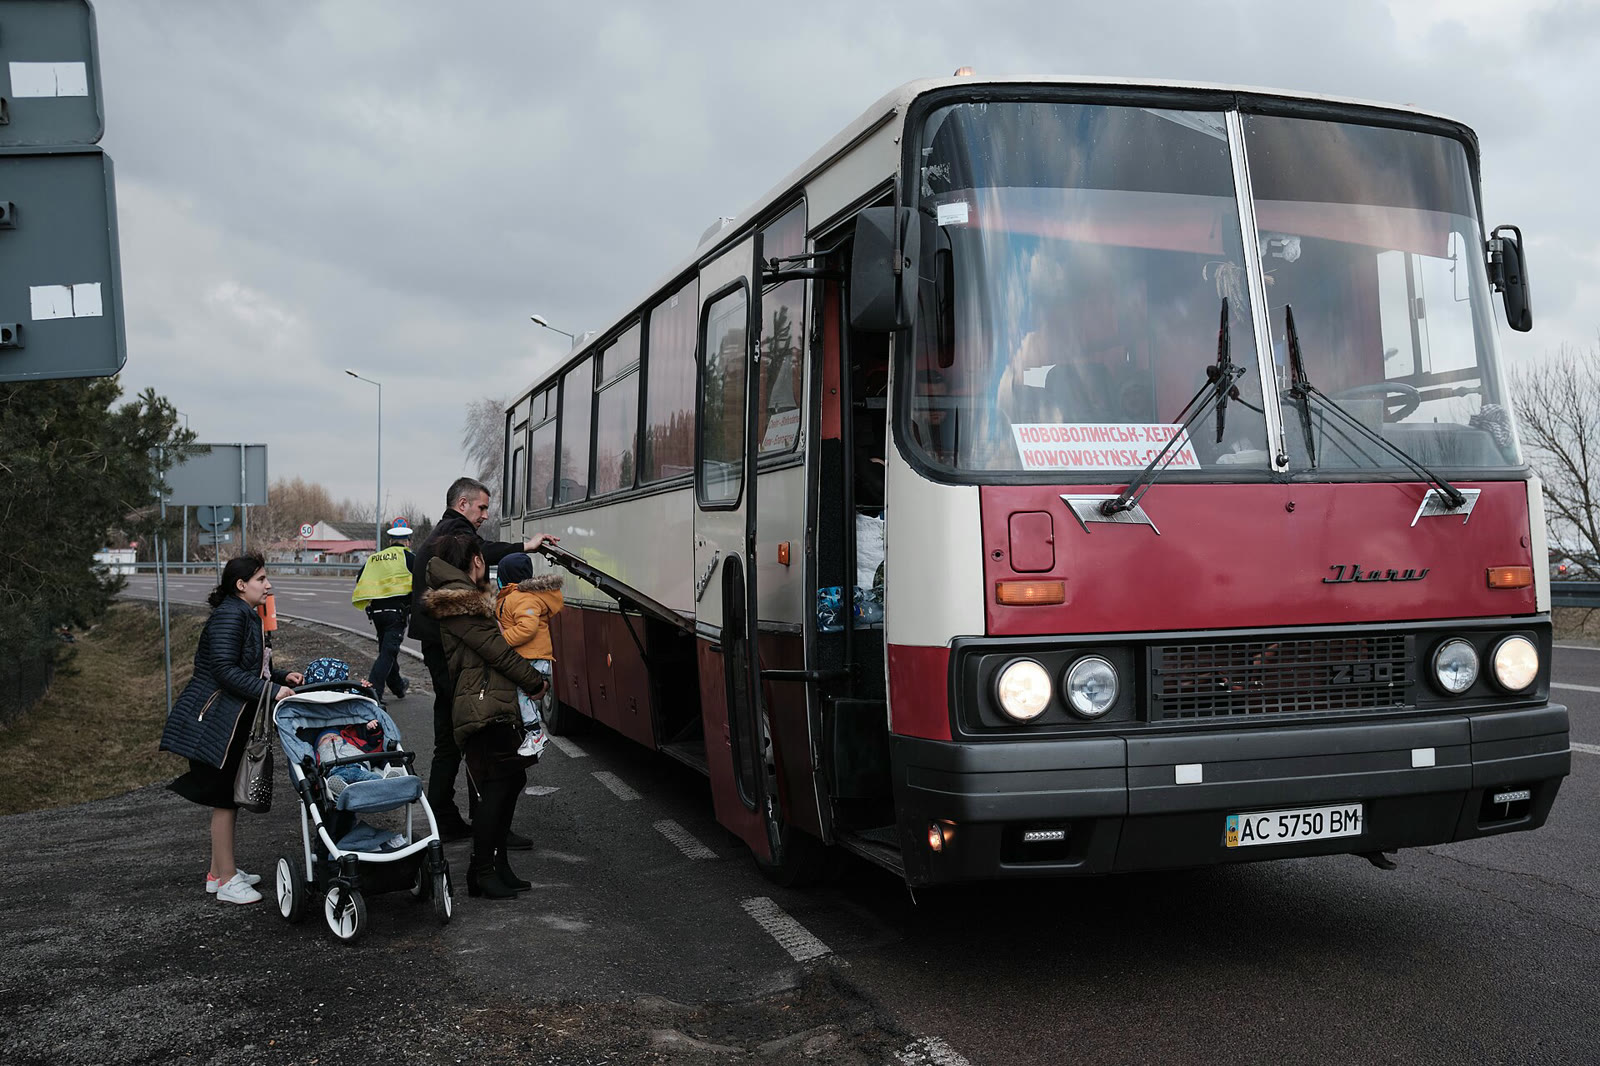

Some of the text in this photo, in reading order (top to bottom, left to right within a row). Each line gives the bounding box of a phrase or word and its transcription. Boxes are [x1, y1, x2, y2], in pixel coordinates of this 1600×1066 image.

[301, 526, 313, 535] 50
[371, 553, 398, 562] POLICJA
[1240, 808, 1358, 842] AC 5750 BM
